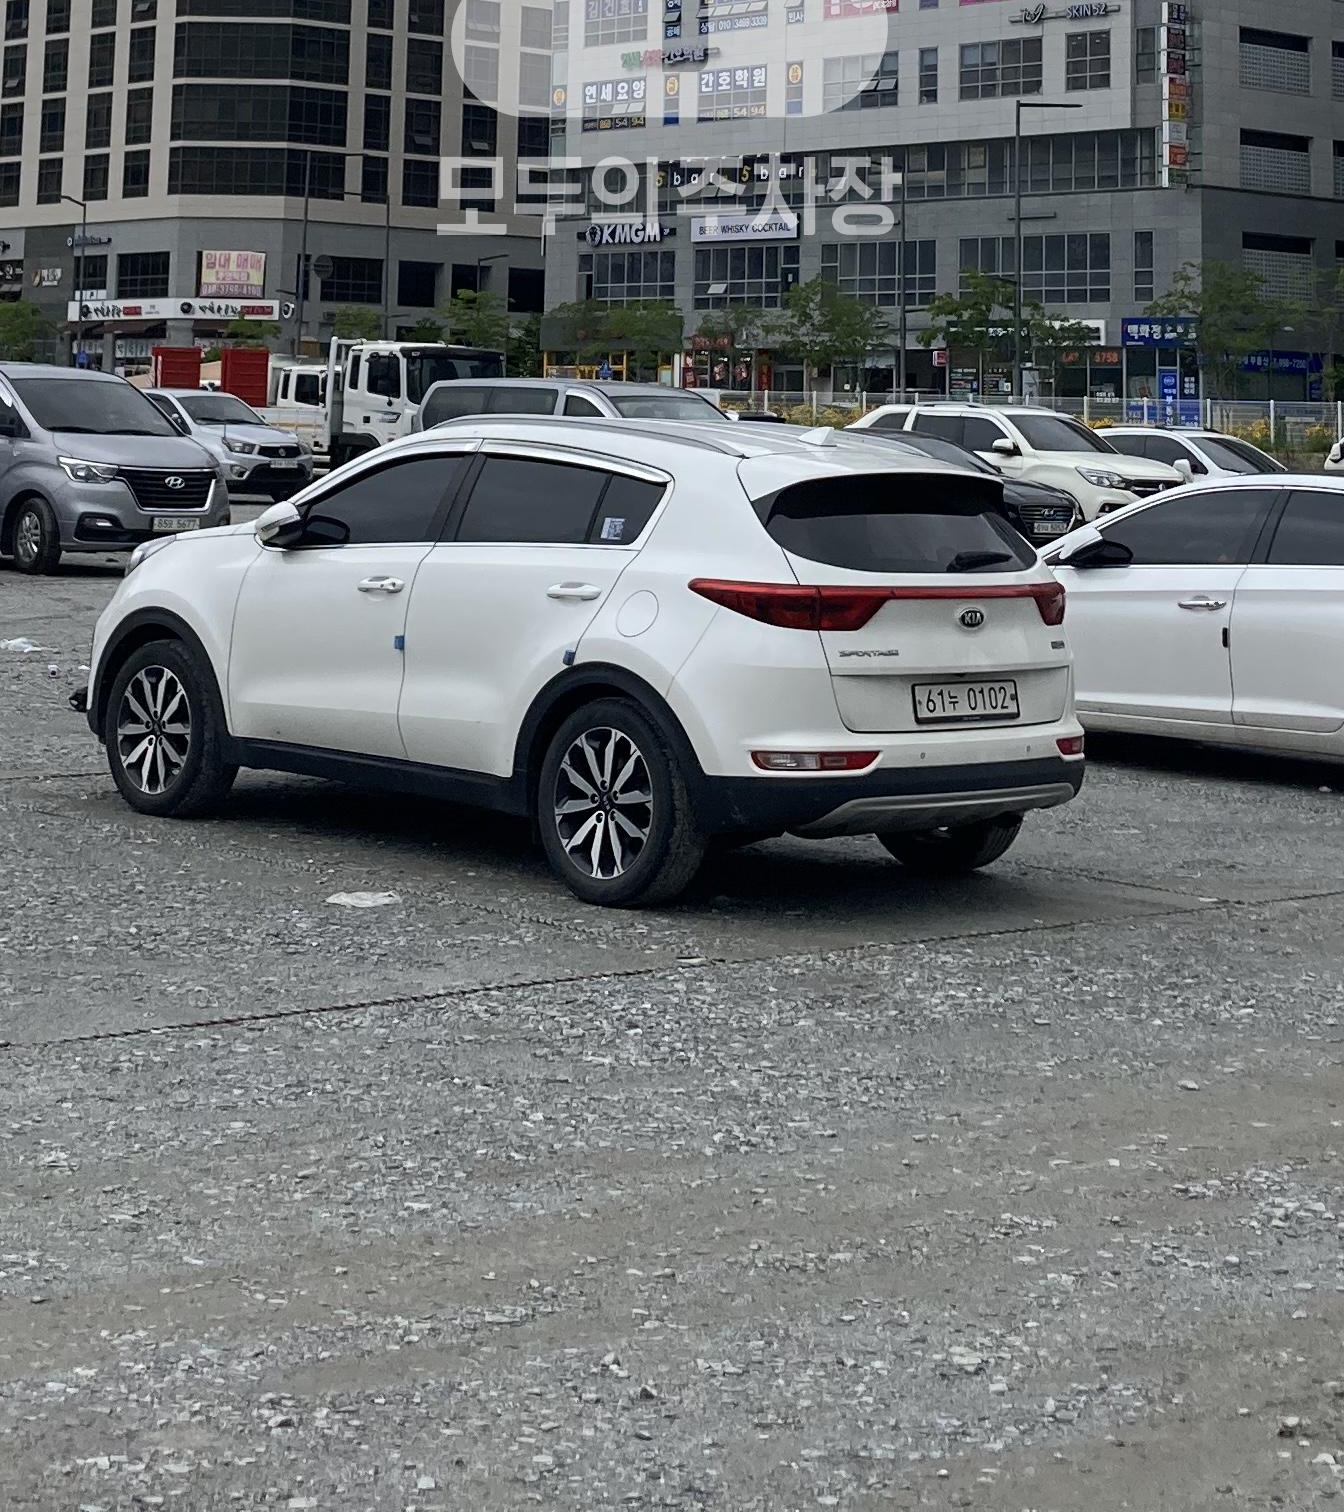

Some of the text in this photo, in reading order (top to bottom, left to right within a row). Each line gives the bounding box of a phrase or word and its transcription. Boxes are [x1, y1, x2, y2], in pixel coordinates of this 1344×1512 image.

[585, 80, 646, 104] 연세요양
[701, 67, 767, 93] 간호학원
[602, 221, 662, 246] KMGM
[720, 223, 750, 235] WHISKY
[751, 222, 792, 233] COCKTAIL
[964, 612, 983, 625] KIA
[925, 685, 1010, 714] 61누 0102
